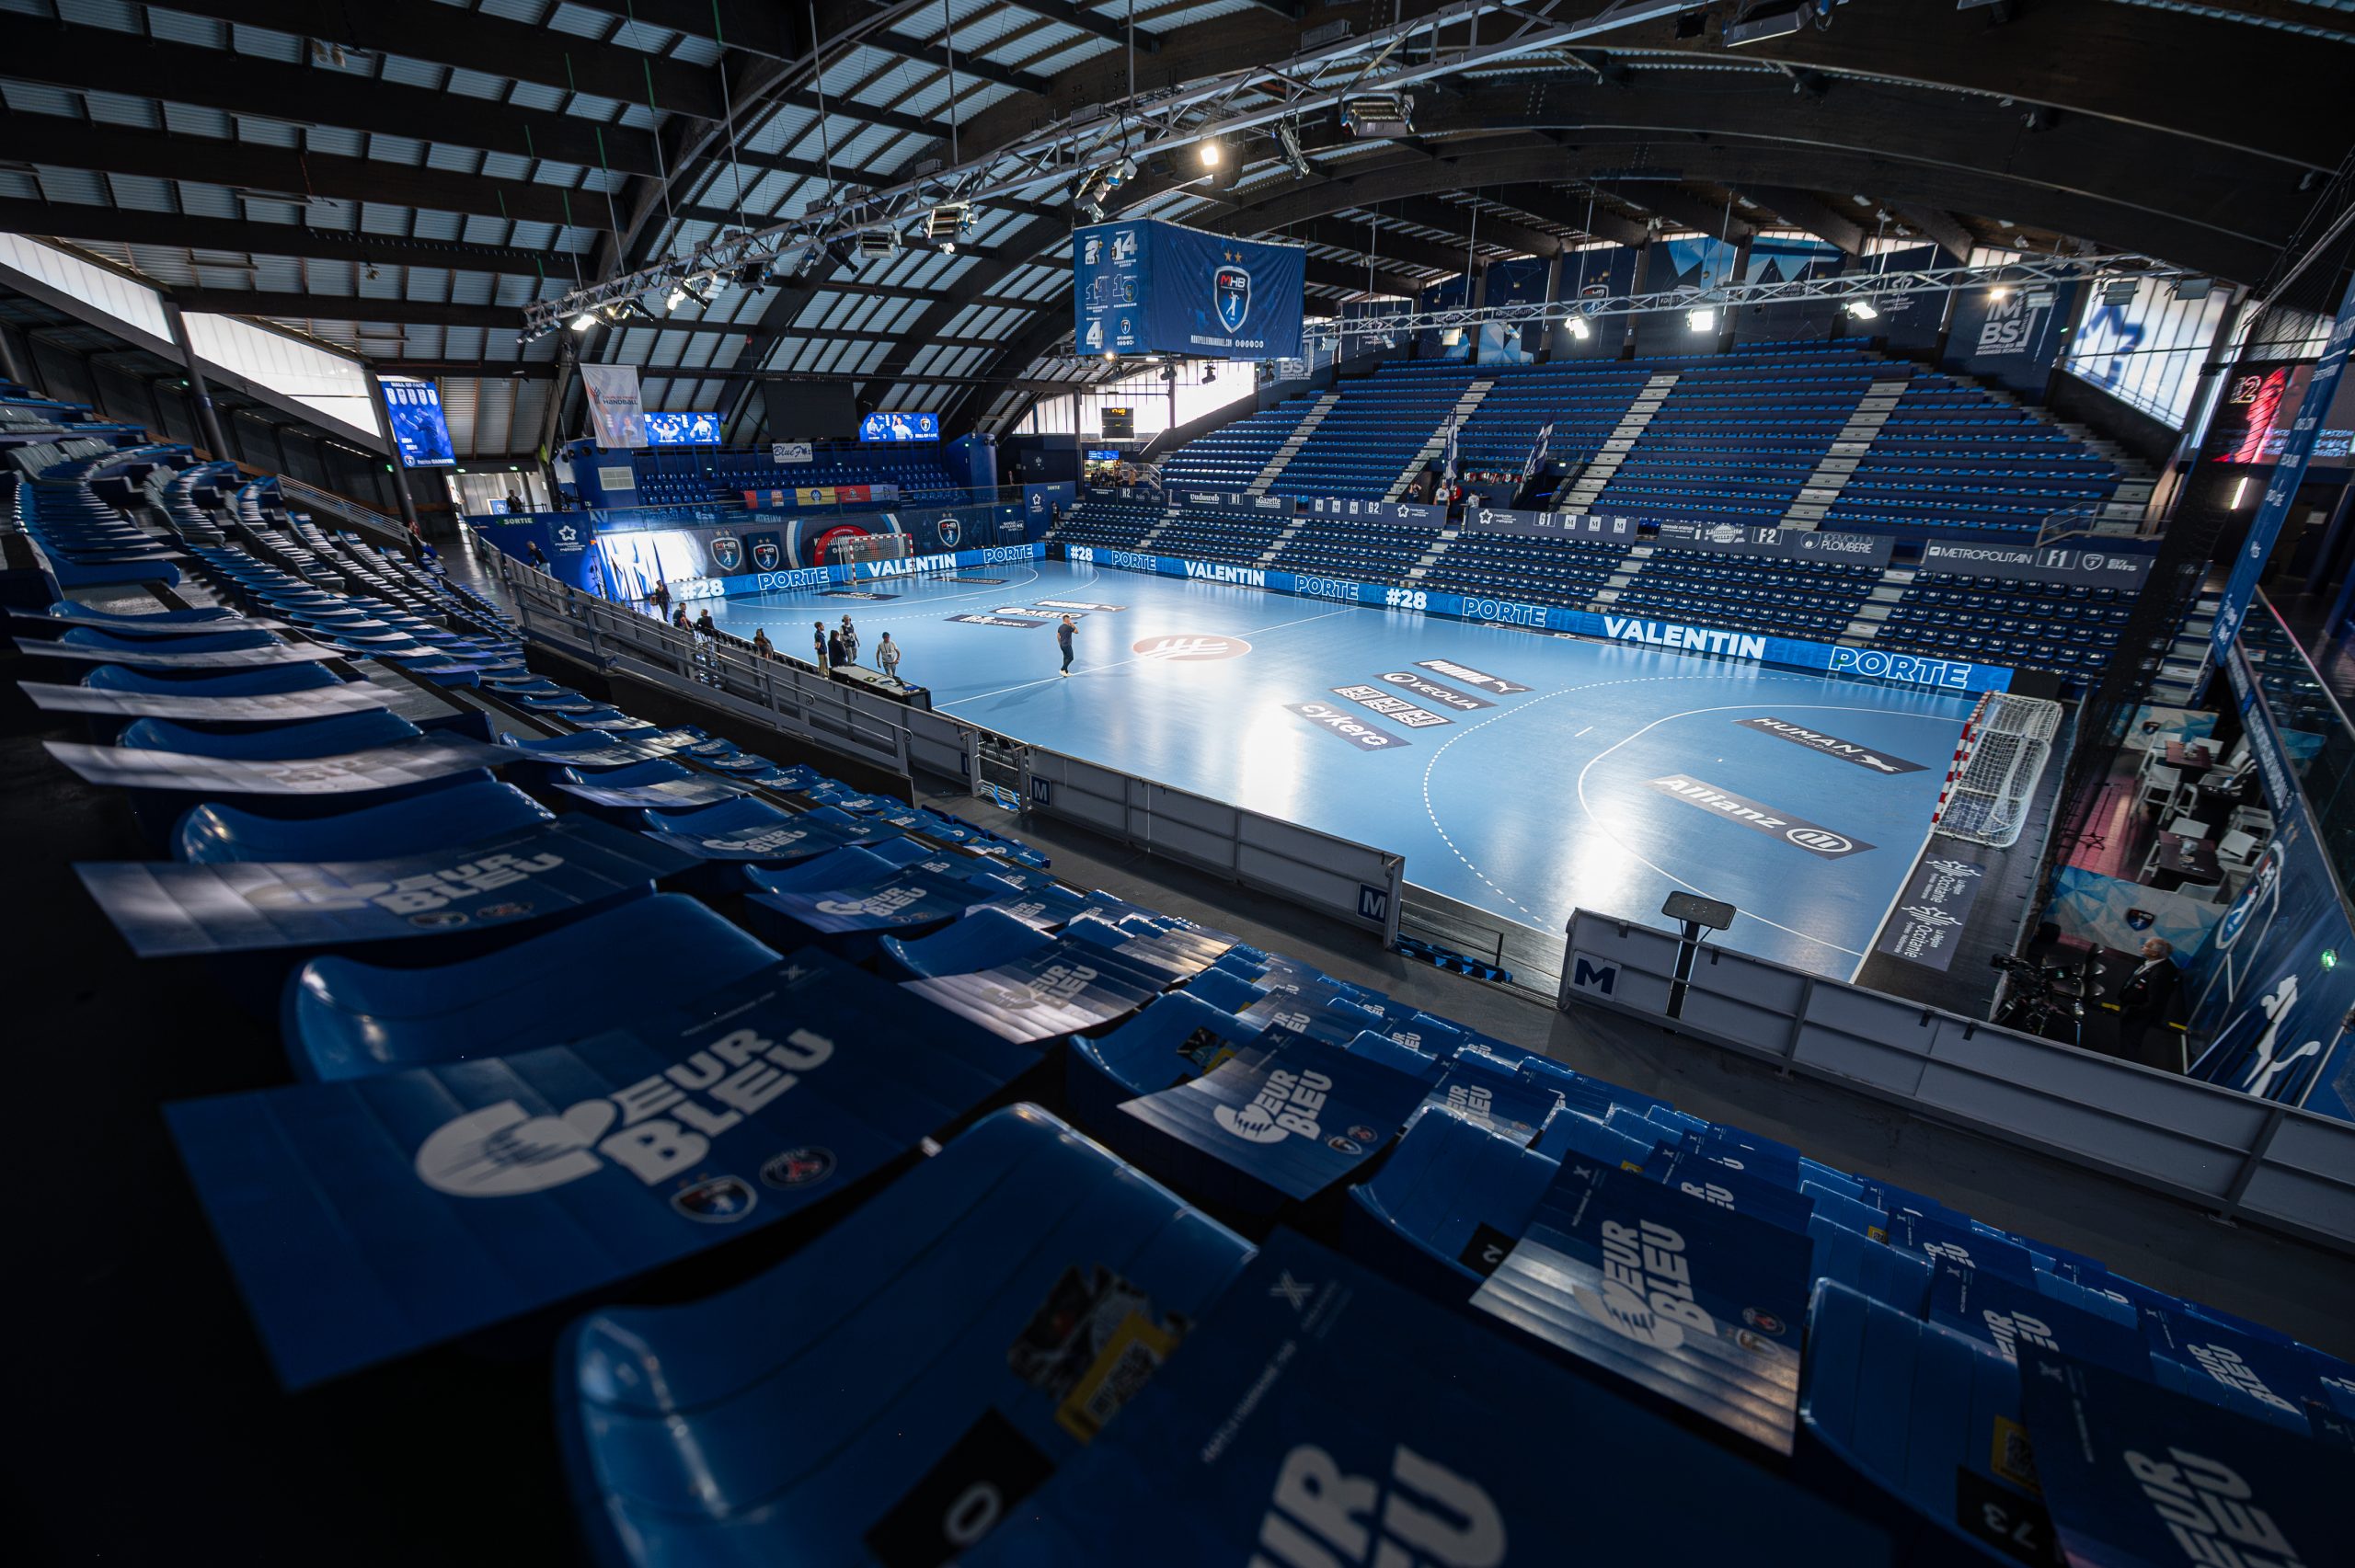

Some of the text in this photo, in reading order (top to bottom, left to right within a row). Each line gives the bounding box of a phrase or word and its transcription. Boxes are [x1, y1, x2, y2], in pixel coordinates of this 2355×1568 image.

[1220, 275, 1246, 288] MHB
[1759, 528, 1776, 544] F2
[867, 554, 957, 577] VALENTIN
[983, 544, 1034, 564] PORTE
[1070, 546, 1093, 562] #28
[1111, 550, 1156, 571] PORTE
[1941, 547, 2033, 565] METROPOLITAN
[2047, 550, 2068, 567] F1
[757, 567, 830, 591] PORTE
[1184, 560, 1265, 586] VALENTIN
[679, 579, 725, 599] #28
[1294, 575, 1360, 601] PORTE
[1385, 588, 1428, 610] #28
[1463, 596, 1547, 628] PORTE
[1603, 615, 1767, 660] VALENTIN
[1419, 660, 1497, 683] PUMA
[1829, 646, 1972, 690] PORTE
[1410, 681, 1479, 710] VEOLIA
[1752, 717, 1865, 754] HUMAN
[1778, 732, 1850, 758] immobilier
[1033, 781, 1049, 803] M
[1653, 778, 1788, 829] Allianz
[750, 829, 808, 854] BLEU
[863, 887, 928, 918] BLEU
[1930, 875, 1956, 904] Occitanie
[1363, 890, 1386, 920] M
[1903, 923, 1933, 958] Occitanie
[1574, 957, 1617, 995] M
[598, 1027, 835, 1187] BLEU
[1276, 1070, 1333, 1140] BLEU
[1638, 1219, 1718, 1338] BLEU
